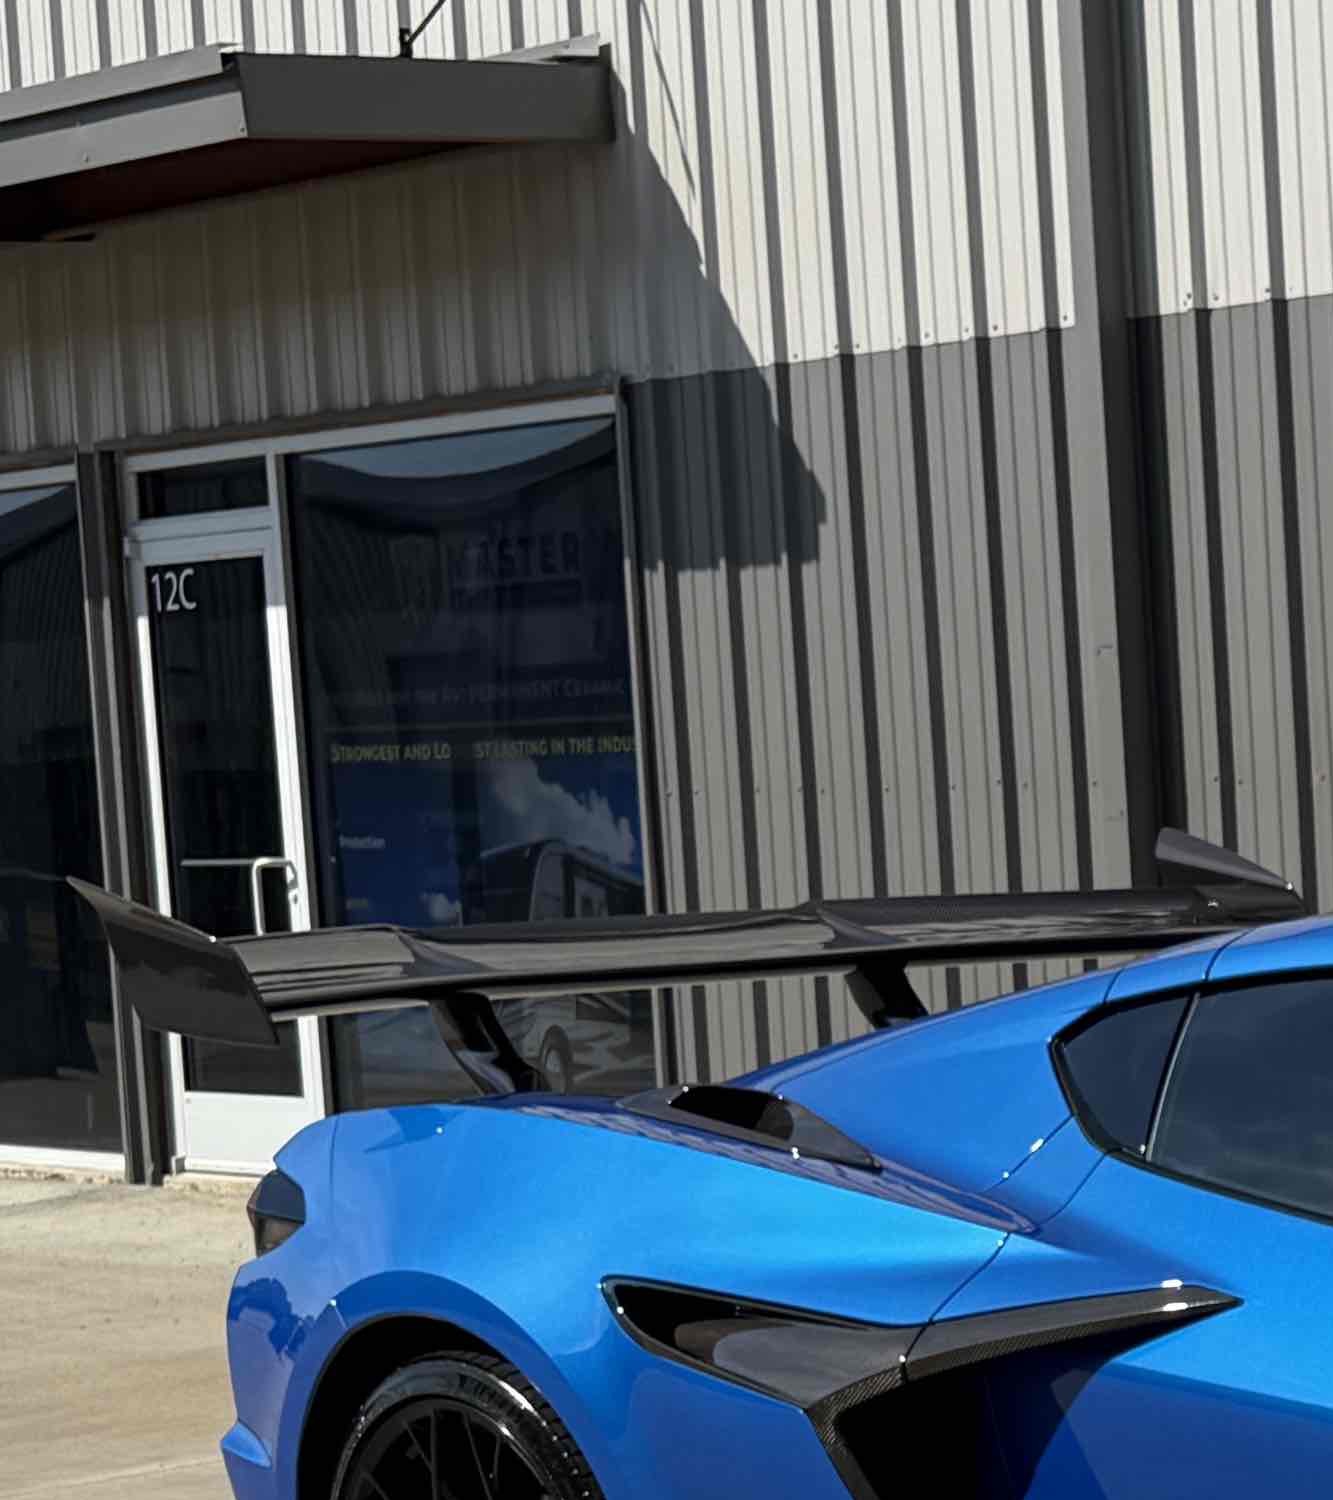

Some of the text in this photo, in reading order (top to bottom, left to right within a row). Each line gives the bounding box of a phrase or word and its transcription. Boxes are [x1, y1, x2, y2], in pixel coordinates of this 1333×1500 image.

[151, 567, 198, 613] 12C
[330, 743, 400, 763] STRONGEST
[403, 743, 431, 761] AND
[551, 737, 566, 756] IN
[568, 736, 595, 755] THE
